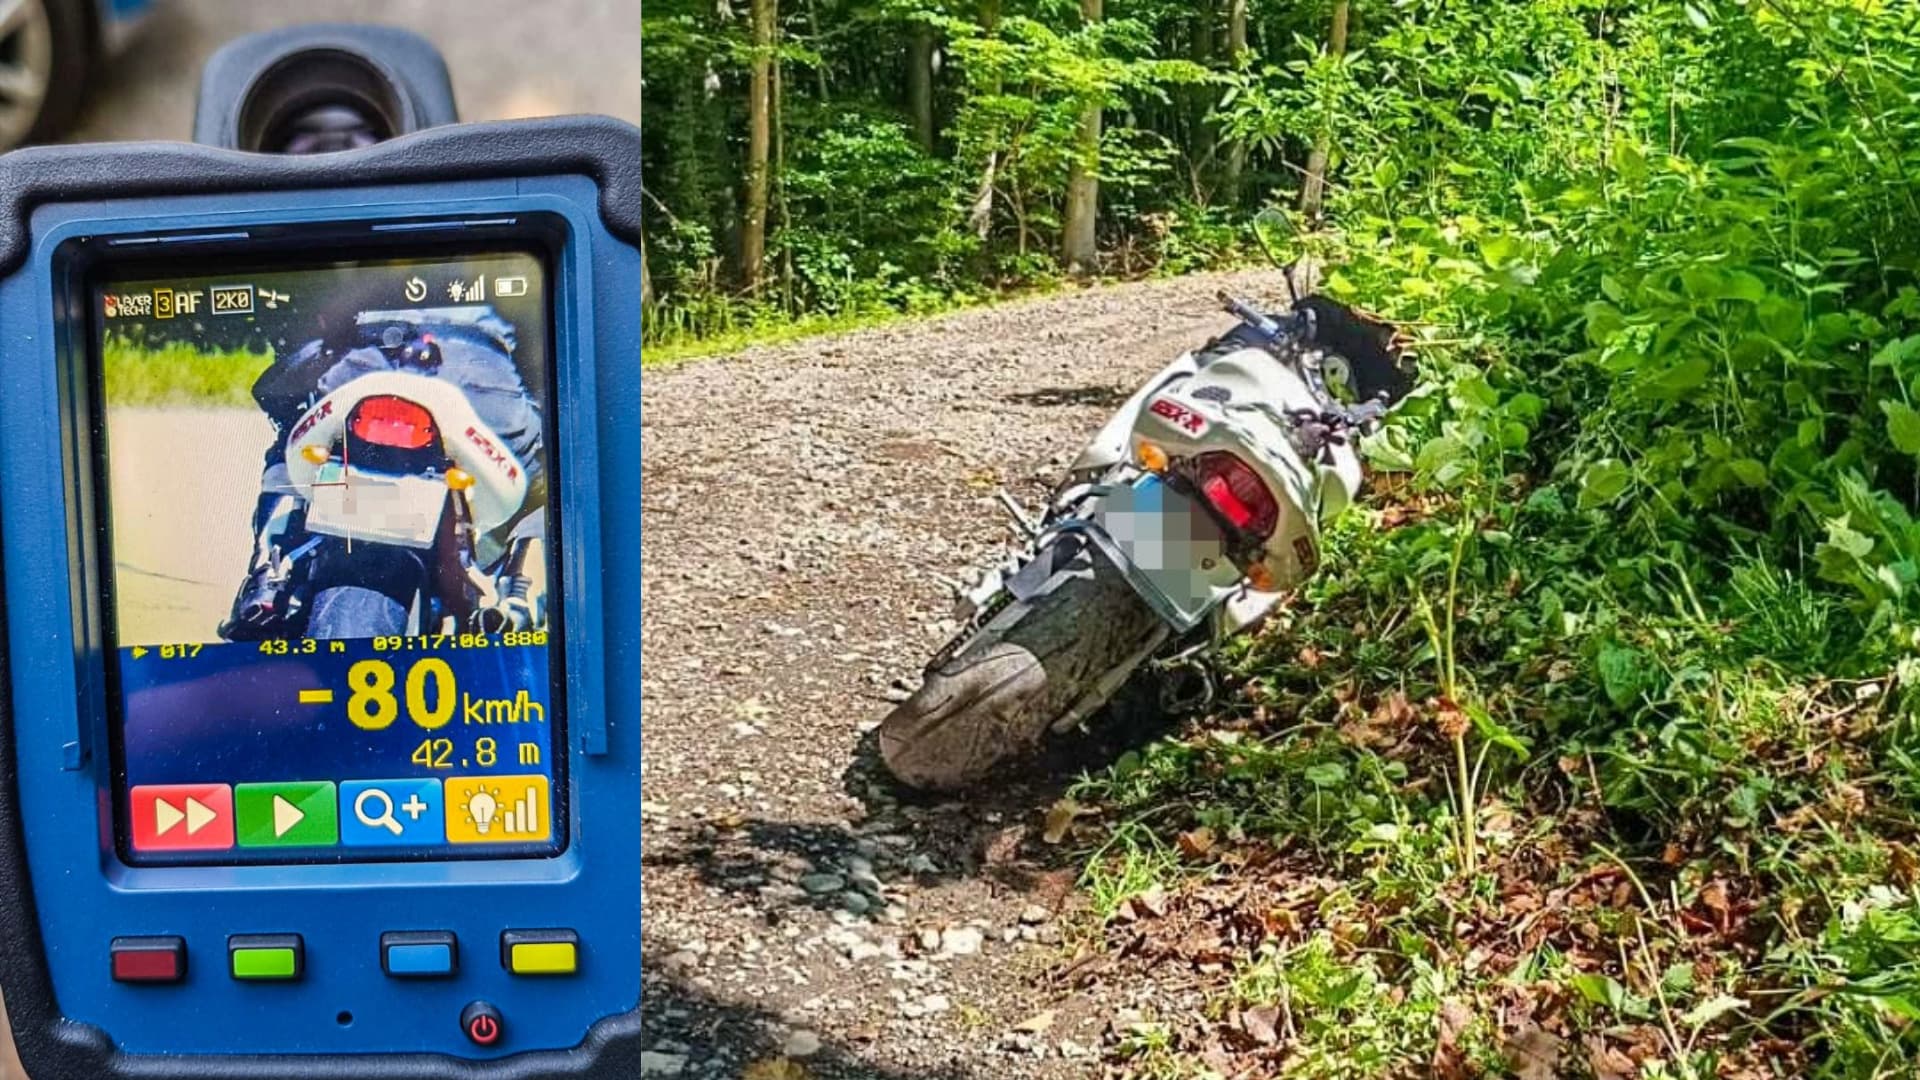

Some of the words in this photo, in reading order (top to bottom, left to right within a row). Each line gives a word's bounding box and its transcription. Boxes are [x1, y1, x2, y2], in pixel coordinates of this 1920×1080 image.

[116, 294, 152, 307] LASER
[159, 296, 170, 313] 3
[175, 291, 203, 314] AF
[258, 638, 317, 655] 43.3
[330, 642, 345, 653] m
[372, 631, 547, 651] 09:17:06.880
[160, 643, 203, 659] 017
[299, 657, 457, 731] -80
[463, 690, 545, 724] km/h
[411, 737, 497, 769] 42.8
[519, 741, 541, 765] m
